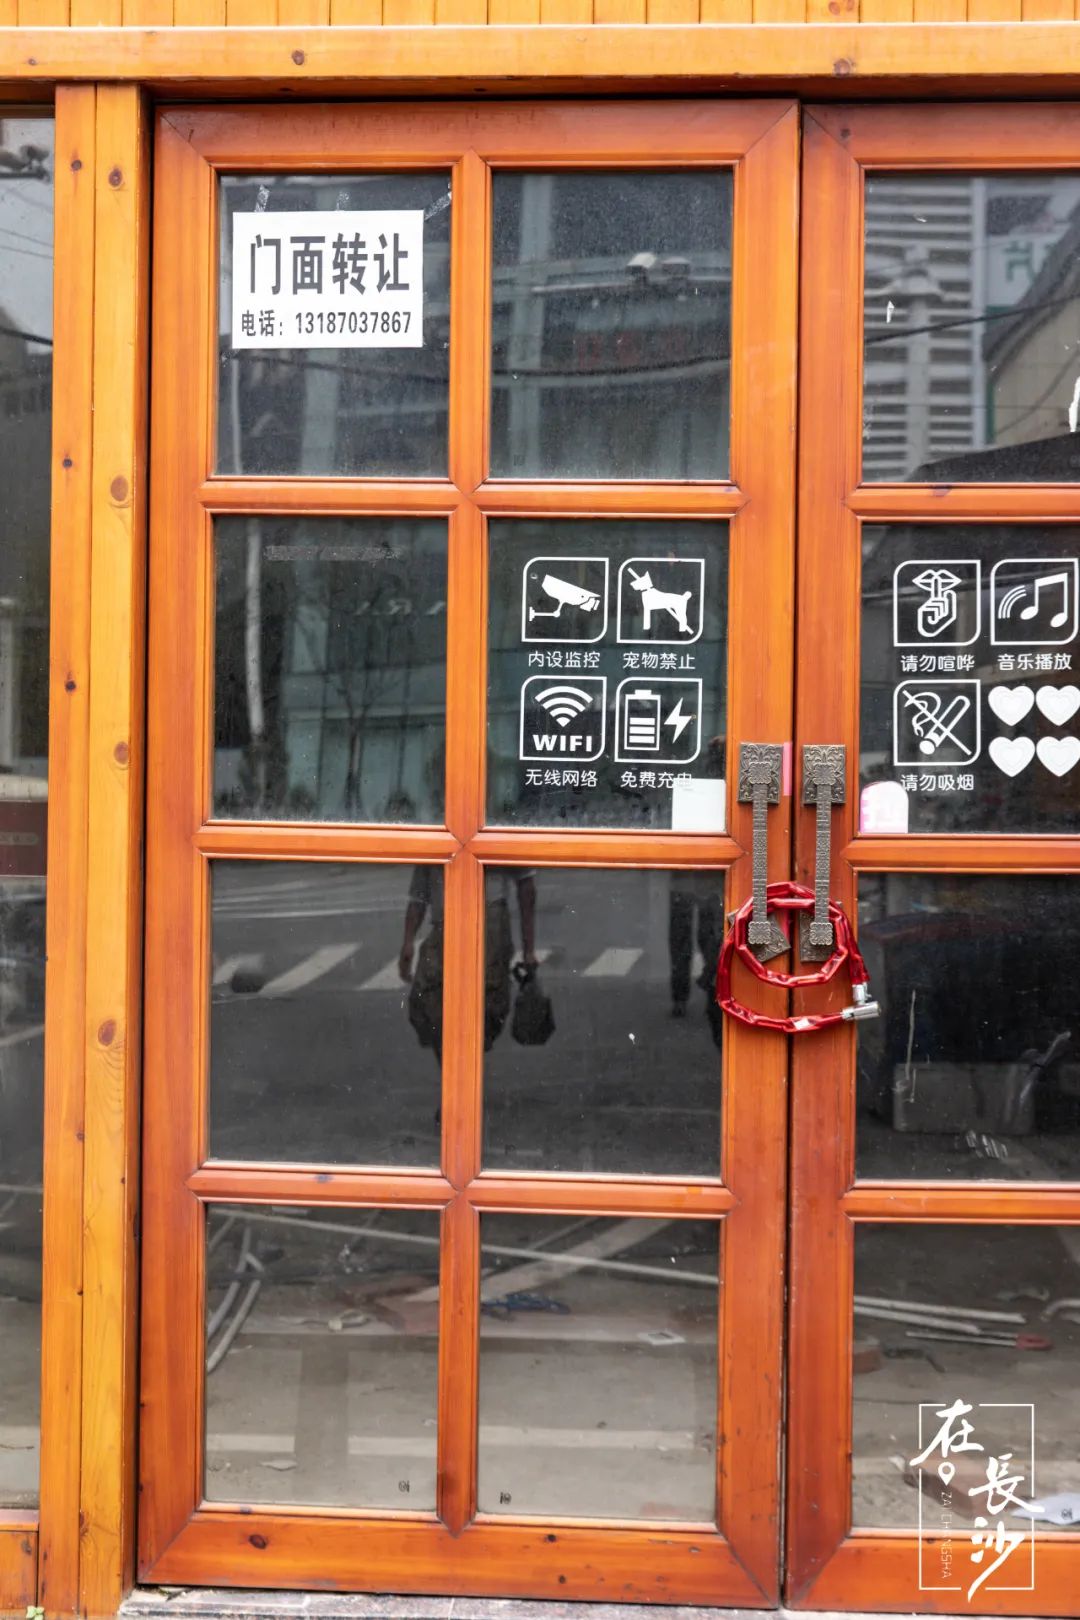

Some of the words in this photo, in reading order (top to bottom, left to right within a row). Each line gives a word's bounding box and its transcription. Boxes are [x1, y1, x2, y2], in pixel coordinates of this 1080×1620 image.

[250, 233, 410, 295] 门面转让
[295, 311, 411, 334] 13187037867
[528, 650, 601, 668] 内设监控
[623, 652, 696, 670] 宠物禁止
[901, 654, 975, 673] 请勿喧哗
[997, 653, 1072, 671] 音乐播放
[532, 734, 593, 752] WIFI
[525, 769, 598, 787] 无线网络
[900, 774, 974, 792] 请勿吸烟
